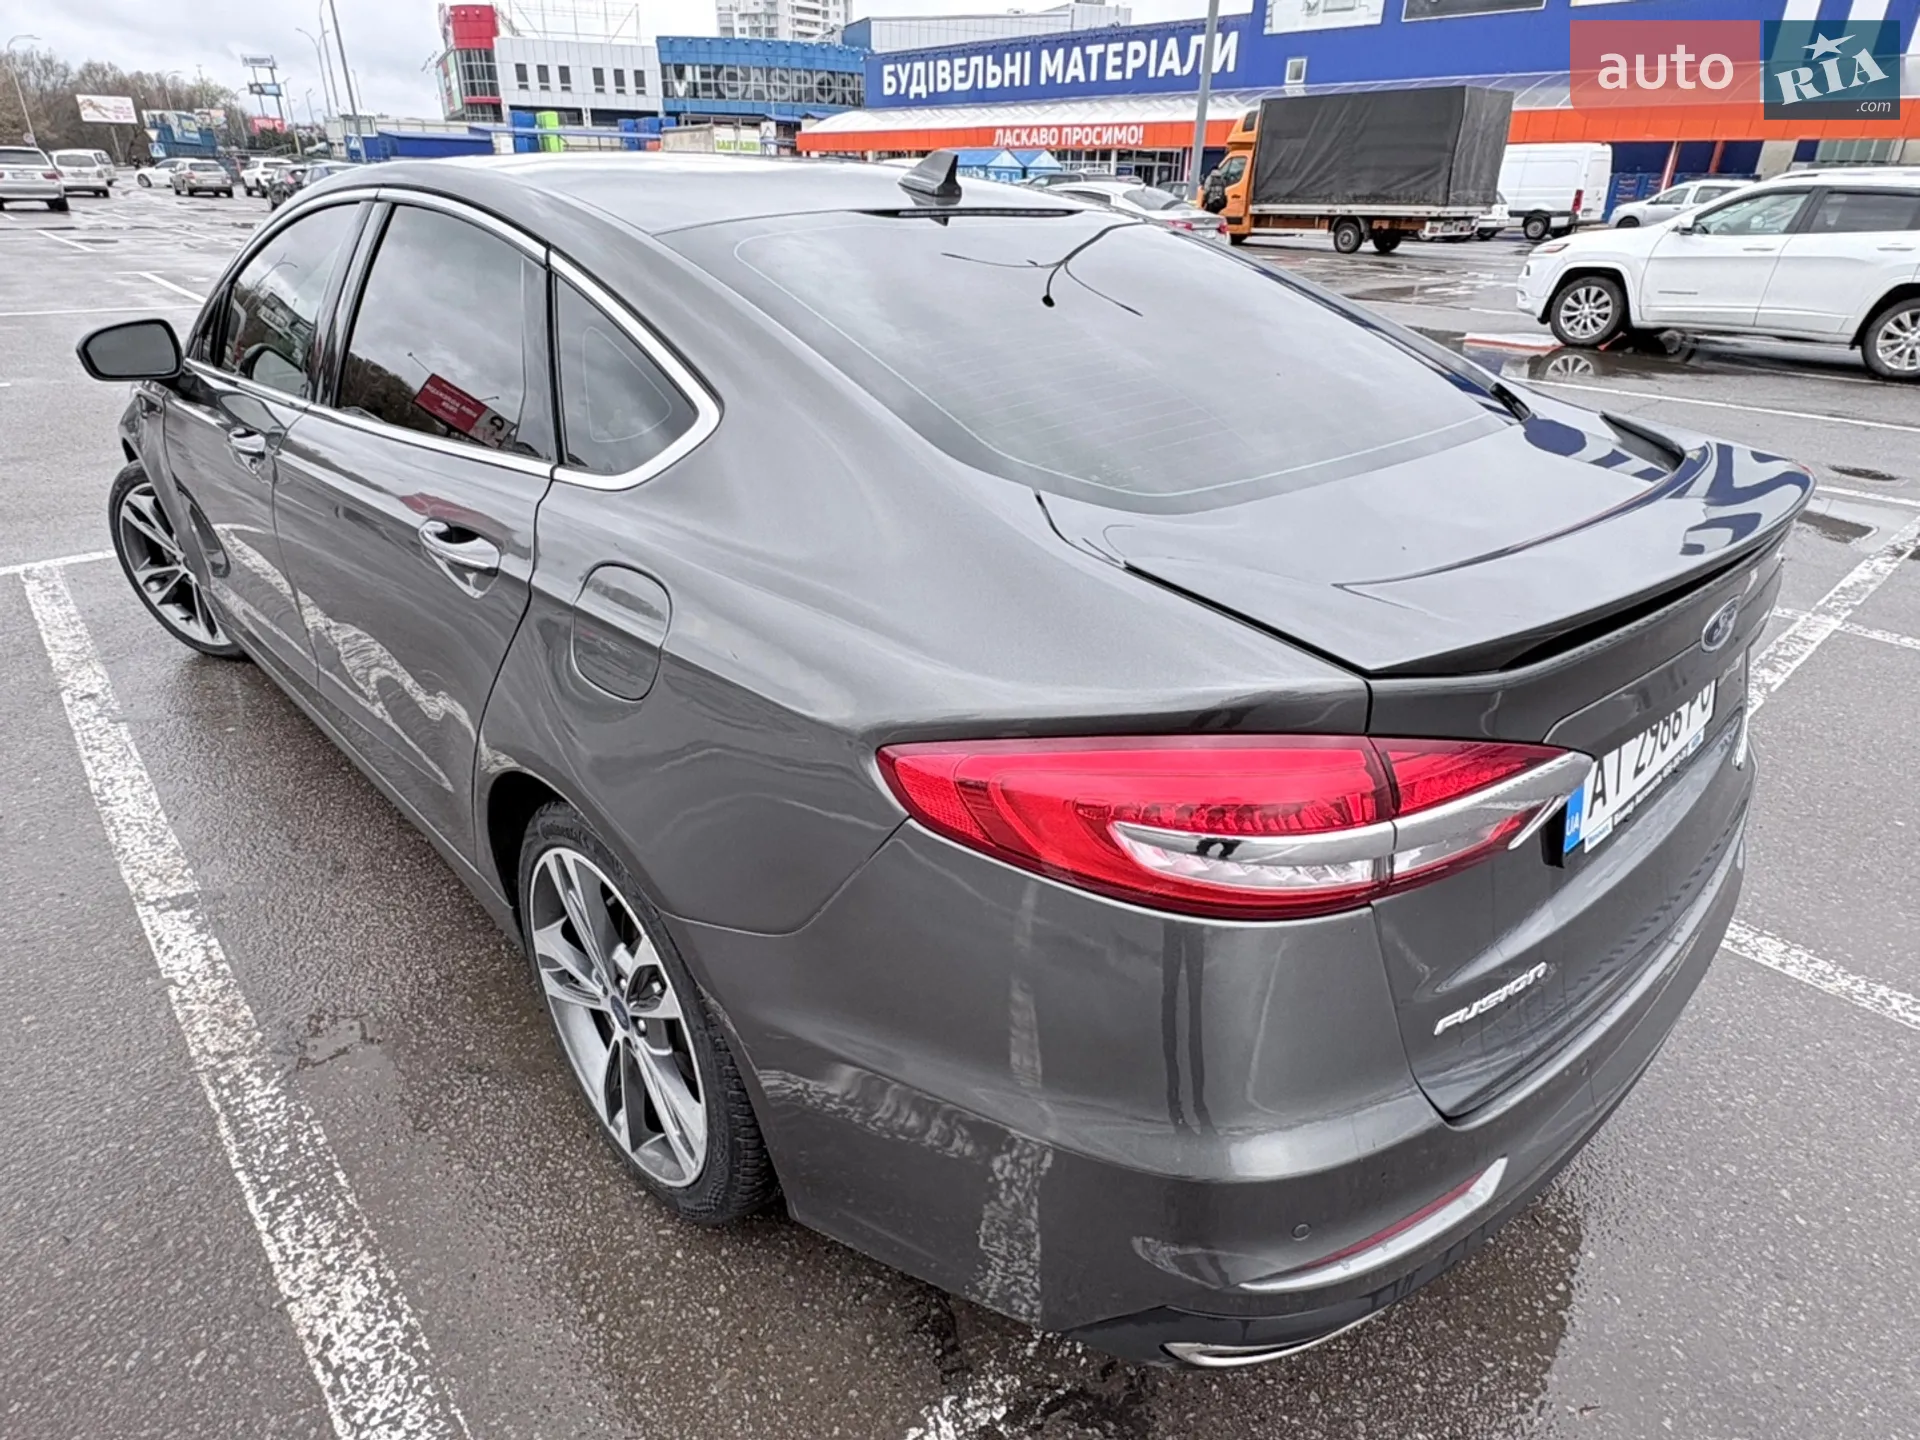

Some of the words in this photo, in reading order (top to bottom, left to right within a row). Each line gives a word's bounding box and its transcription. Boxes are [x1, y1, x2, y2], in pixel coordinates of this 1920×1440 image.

[882, 51, 1031, 99] БУДІВЕЛЬНІ
[1040, 31, 1239, 85] МАТЕРІАЛИ
[993, 127, 1059, 146] ЛАСКАВО
[1061, 124, 1144, 145] ПРОСИМО!
[1566, 811, 1580, 837] UA
[1433, 961, 1548, 1036] FUSION
